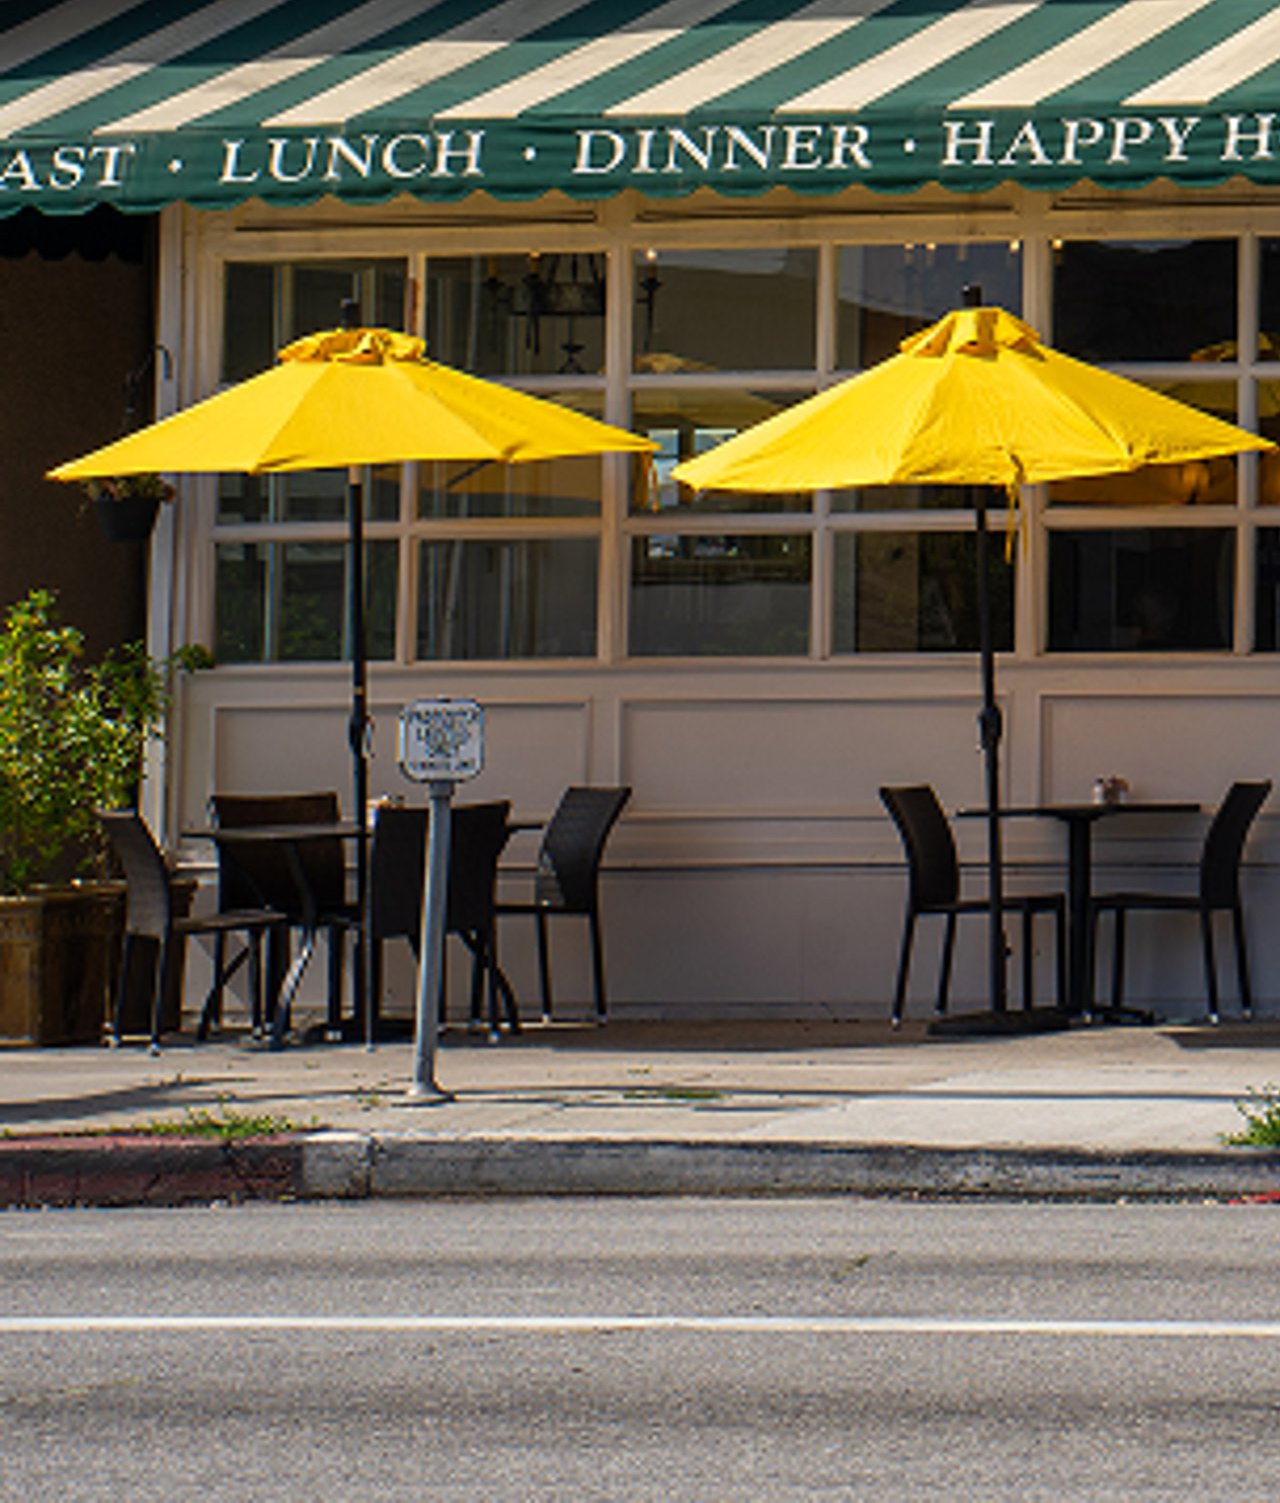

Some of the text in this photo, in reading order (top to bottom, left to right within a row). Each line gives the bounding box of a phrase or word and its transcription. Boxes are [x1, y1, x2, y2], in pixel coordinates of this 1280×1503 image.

[0, 144, 136, 190] AST
[219, 130, 486, 184] LUNCH
[572, 124, 872, 175] DINNER
[941, 116, 1201, 166] HAPPY
